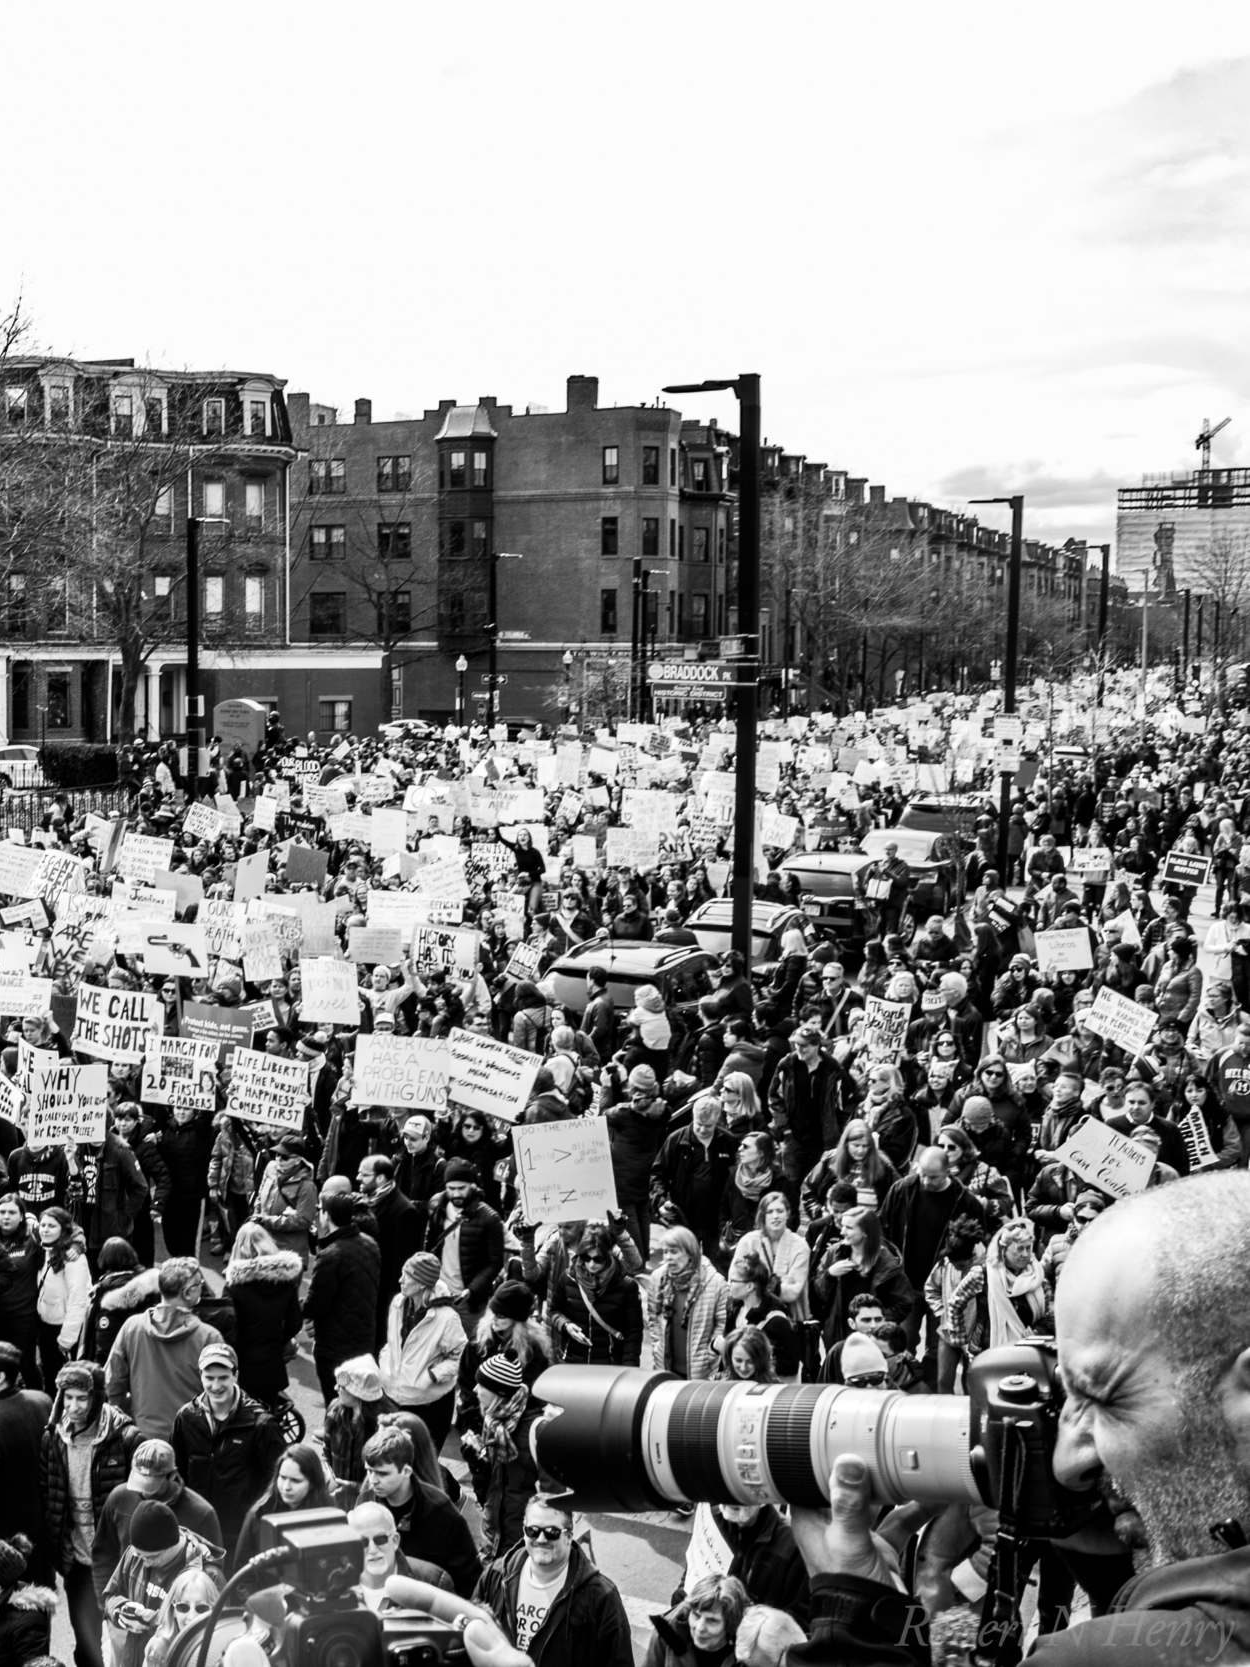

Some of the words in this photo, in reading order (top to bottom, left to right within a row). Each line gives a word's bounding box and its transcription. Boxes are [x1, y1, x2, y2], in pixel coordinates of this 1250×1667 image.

[663, 665, 719, 681] BRADDOCK
[722, 672, 732, 680] PK
[653, 689, 688, 698] HISTORIC
[689, 690, 724, 698] DISTRICT
[295, 760, 320, 772] BLOOD
[1169, 857, 1188, 866] BLACK
[1189, 860, 1207, 870] LIVES
[1173, 866, 1199, 875] MATTER
[208, 902, 235, 918] GUNS
[55, 923, 94, 950] ARE
[245, 930, 268, 943] NOT
[419, 928, 457, 948] HISTORY
[247, 944, 278, 959] ONE
[419, 947, 438, 962] HAS
[441, 948, 456, 964] ITS
[514, 946, 540, 967] NO!
[246, 959, 280, 976] MORE
[457, 965, 474, 980] YOU
[79, 989, 102, 1014] WE
[107, 995, 150, 1022] CALL
[869, 1001, 905, 1018] Thank
[1101, 990, 1113, 1001] HE
[1117, 999, 1153, 1021] WOULDN'T
[181, 1015, 204, 1027] Protect
[204, 1019, 219, 1030] kids,
[232, 1025, 249, 1033] guns.
[1109, 1015, 1132, 1034] PEOPLE
[76, 1016, 100, 1043] THE
[101, 1024, 151, 1052] SHOTS
[159, 1038, 194, 1056] MARCH
[197, 1042, 219, 1059] FOR
[370, 1034, 450, 1054] AMERICA
[236, 1050, 260, 1072] LIFE,
[261, 1055, 306, 1080] LIBERTY,
[372, 1052, 398, 1066] HAS
[403, 1052, 420, 1067] A
[41, 1067, 82, 1094] WHY
[362, 1065, 448, 1085] PROBLEM
[467, 1068, 491, 1080] MEAN
[145, 1074, 167, 1091] 20
[171, 1081, 200, 1097] FIRST
[270, 1077, 307, 1095] PURSUIT
[365, 1082, 400, 1099] WITH
[400, 1083, 450, 1106] GUNS
[37, 1093, 73, 1112] SHOULD
[167, 1094, 213, 1110] GRADERS
[245, 1086, 295, 1107] HAPPINESS
[230, 1097, 263, 1115] COMES
[268, 1107, 301, 1122] FIRST
[521, 1126, 535, 1136] DO
[544, 1123, 561, 1132] THE
[568, 1119, 596, 1129] MATH
[523, 1147, 537, 1171] 1
[533, 1152, 555, 1162] child
[572, 1142, 585, 1150] all
[591, 1140, 605, 1148] the
[579, 1148, 598, 1160] guns
[1069, 1150, 1091, 1171] Gun
[528, 1183, 562, 1195] thoughts
[581, 1188, 607, 1200] enough
[532, 1204, 562, 1217] prayers
